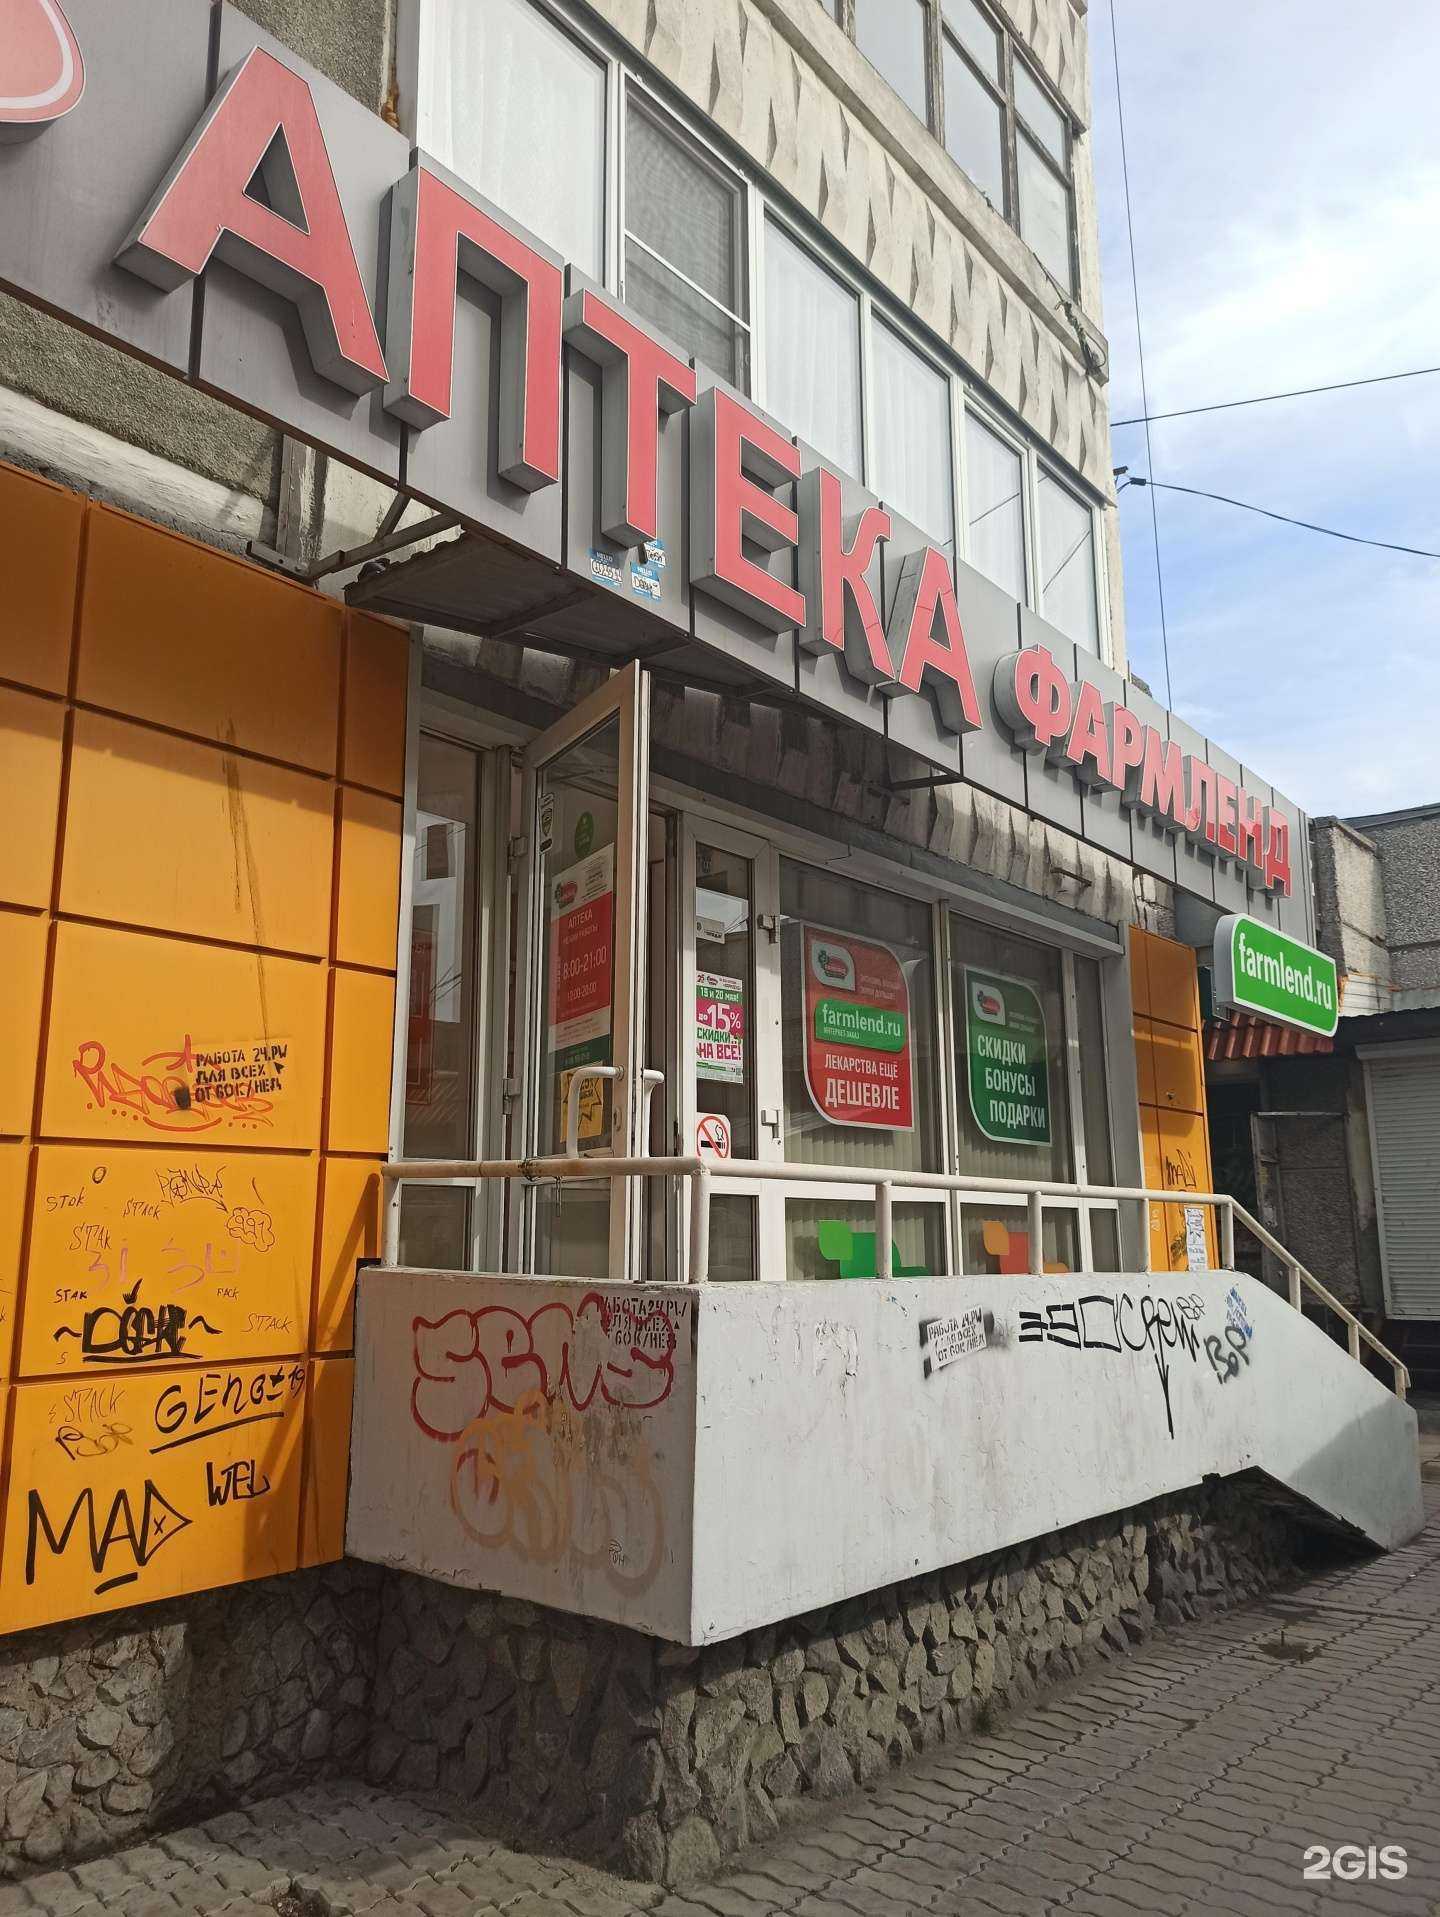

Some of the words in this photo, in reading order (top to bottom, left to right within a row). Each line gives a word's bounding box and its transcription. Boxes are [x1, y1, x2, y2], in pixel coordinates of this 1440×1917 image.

[132, 45, 984, 731] АПТЕКА
[1013, 643, 1292, 898] ФАРМЛЕНД
[568, 908, 593, 929] АПТЕКА
[1238, 932, 1333, 1011] farmlend.ru
[707, 1002, 741, 1032] 15%
[822, 1004, 901, 1037] farmlend.ru
[697, 1027, 731, 1044] СКИДКИ
[977, 1034, 1026, 1066] СКИДКИ
[196, 1049, 246, 1067] РАБОТА
[699, 1043, 714, 1059] НА
[716, 1041, 742, 1060] ВСЁ!
[825, 1053, 878, 1076] ЛЕКАРСТВА
[195, 1069, 226, 1085] ДЛЯ
[231, 1063, 266, 1080] ВСЕХ
[985, 1068, 1036, 1097] БОНУСЫ
[194, 1085, 212, 1103] ОТ
[825, 1077, 900, 1110] ДЕШЕВЛЕ
[990, 1100, 1046, 1130] ПОДАРКИ
